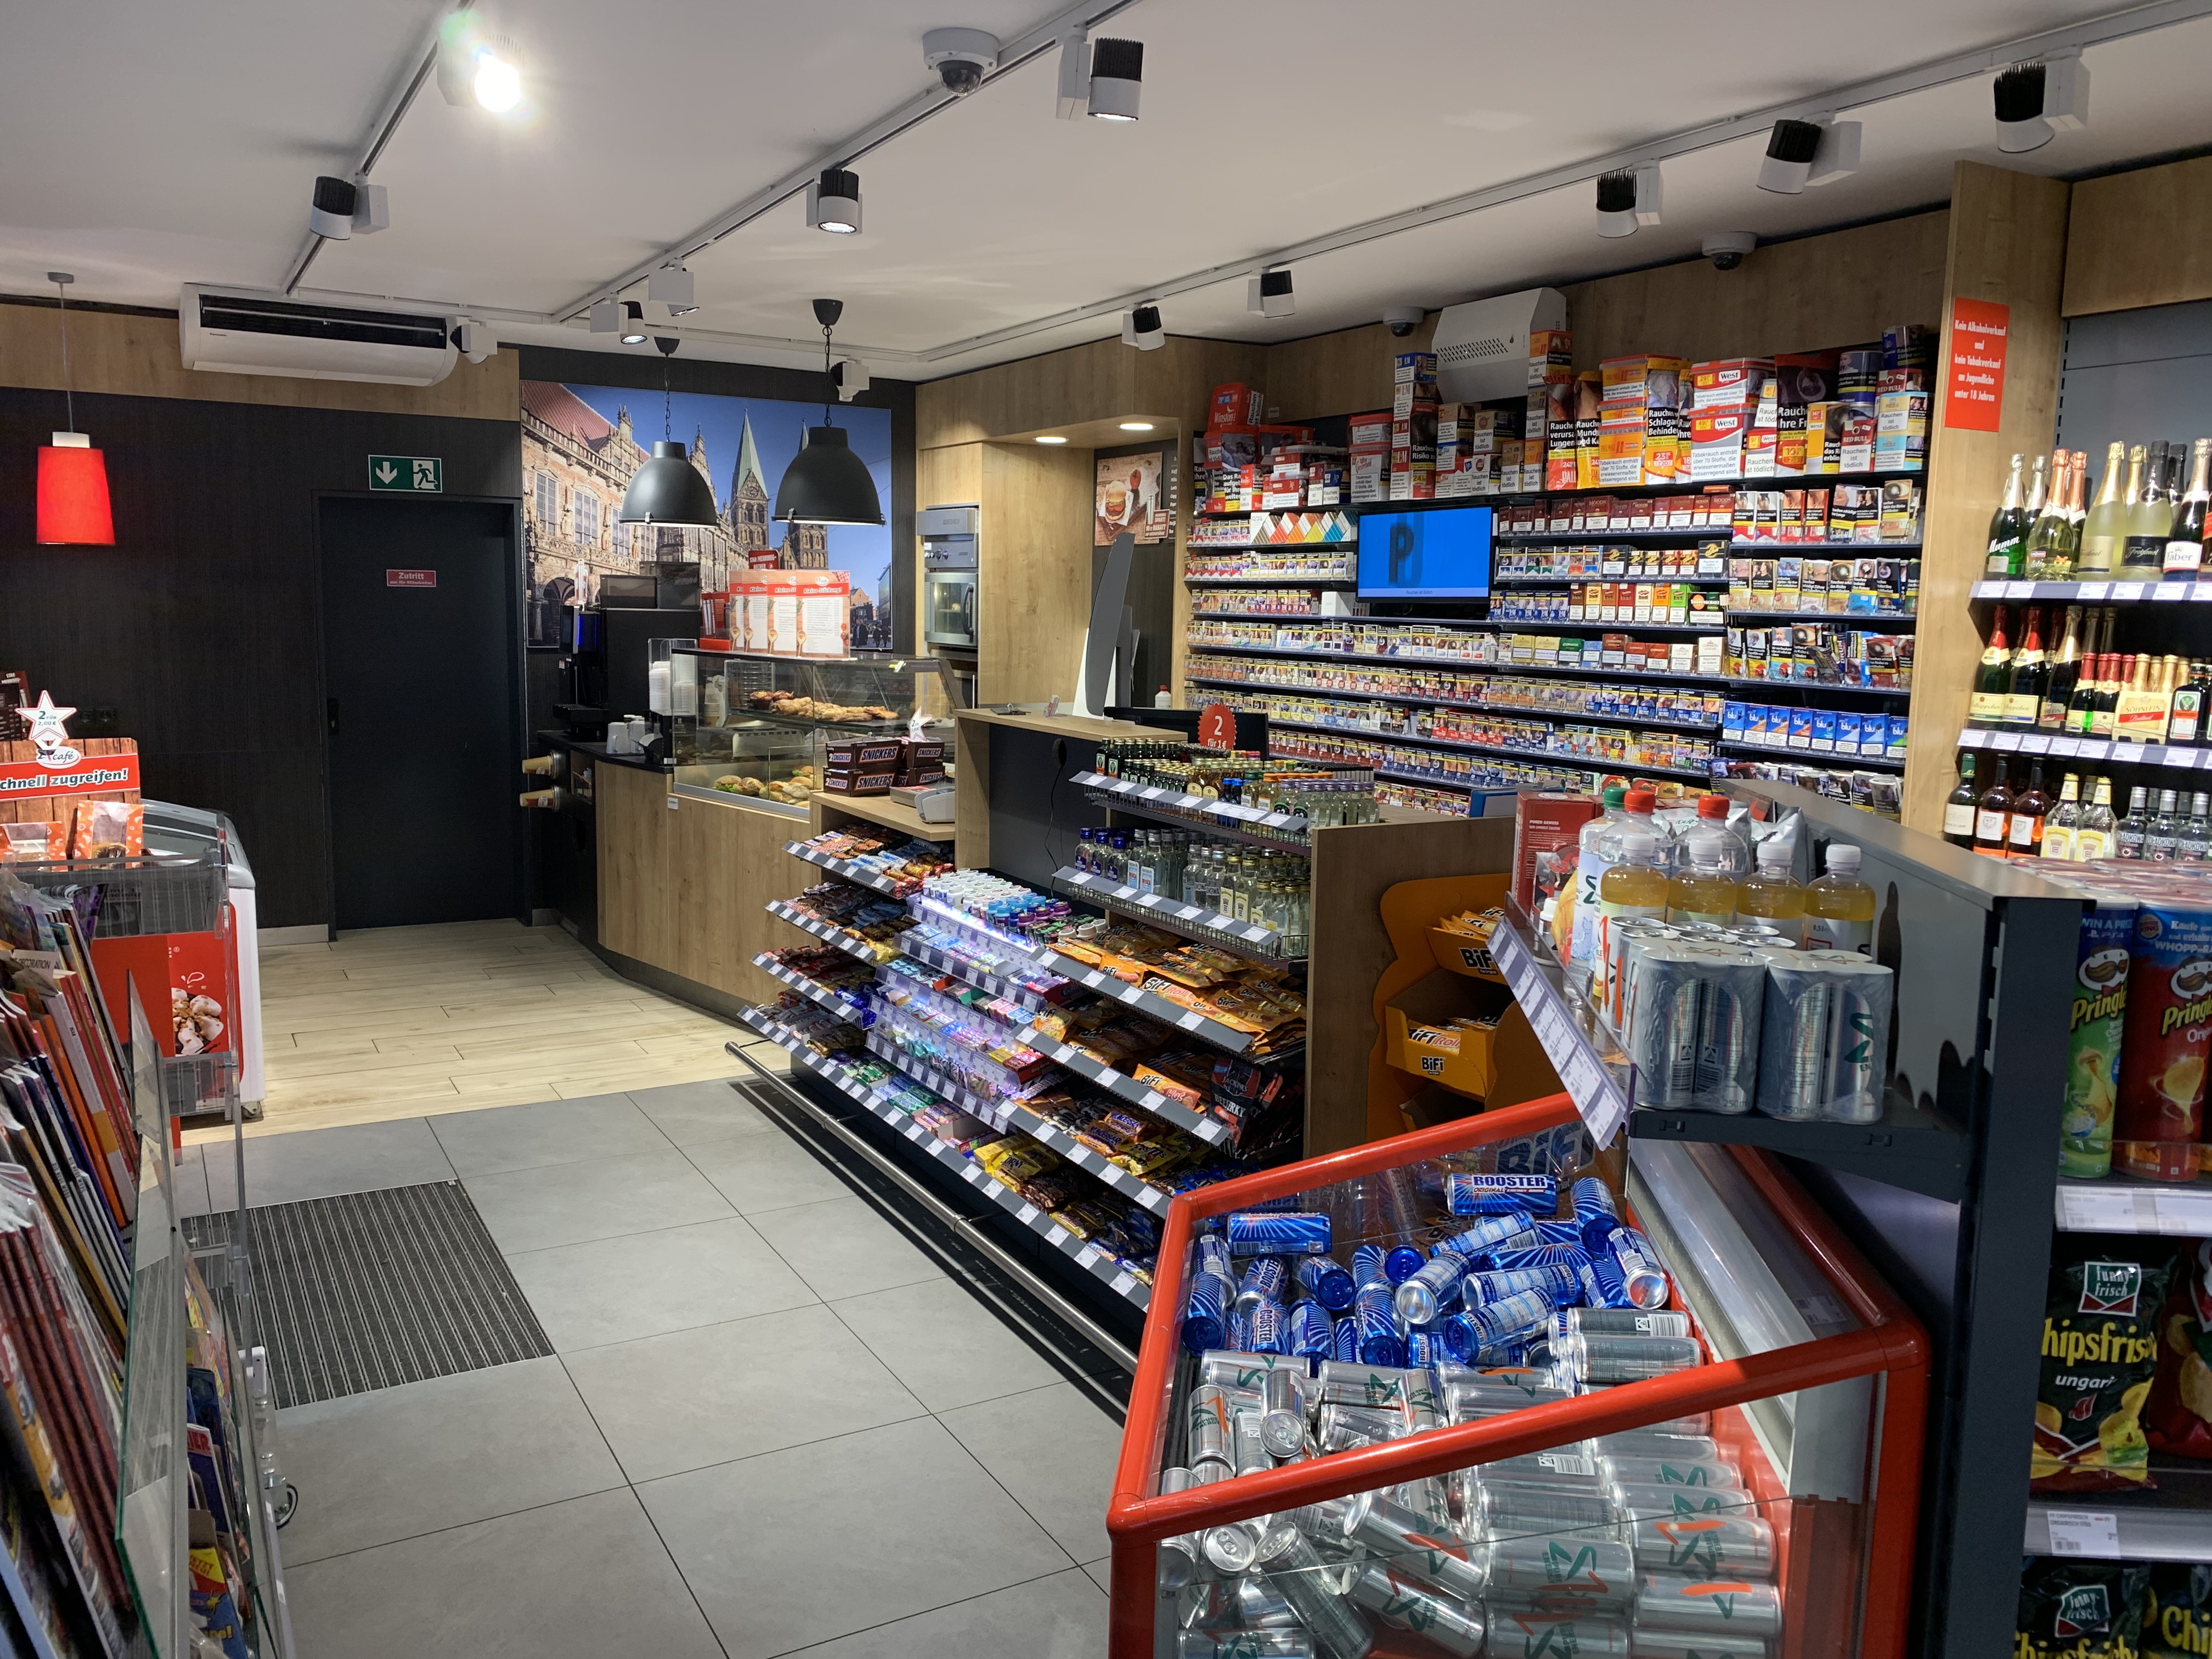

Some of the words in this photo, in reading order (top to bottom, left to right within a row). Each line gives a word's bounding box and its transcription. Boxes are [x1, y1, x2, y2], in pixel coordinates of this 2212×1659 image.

[1955, 320, 1967, 330] Kein
[1974, 340, 1984, 350] und
[1955, 354, 1966, 365] kein
[1967, 356, 2001, 369] Tabakverkauf
[1966, 373, 1995, 385] Jugendliche
[1955, 390, 1968, 399] unter
[1970, 390, 1977, 399] 18
[1978, 391, 1995, 402] Jahren
[1215, 412, 1234, 424] Winston
[1988, 535, 2020, 556] Mumm
[2128, 546, 2159, 558] Freixenet
[2126, 704, 2160, 713] SÖHNLEIN
[38, 711, 46, 719] 2
[1750, 713, 1758, 721] blu
[1771, 715, 1781, 723] blu
[1214, 716, 1223, 736] 2
[1816, 720, 1826, 728] blu
[1841, 722, 1851, 730] blu
[1865, 723, 1875, 732] blu
[1893, 727, 1903, 735] blu
[1207, 738, 1217, 747] für
[53, 751, 75, 764] café
[829, 753, 833, 762] 2
[861, 748, 899, 761] SNICKERS
[0, 777, 46, 789] chnell
[51, 769, 127, 785] zugreifen!
[825, 778, 830, 786] 2
[830, 778, 847, 788] SNICKERS
[858, 775, 893, 788] SNICKERS
[921, 773, 943, 782] SNICKERS
[2104, 919, 2113, 928] A
[2171, 921, 2198, 931] Kaufe
[1460, 948, 1498, 969] BiF
[1103, 966, 1117, 977] BiFi
[2070, 985, 2127, 1031] Pringle
[1421, 1057, 1444, 1071] BiFi
[1141, 1075, 1163, 1086] BiFi
[1167, 1089, 1185, 1101] Hot
[1473, 1176, 1547, 1187] BOOSTER
[1562, 1265, 1577, 1296] BOOSTER
[2096, 1266, 2134, 1283] funny-
[2095, 1283, 2128, 1296] frisch
[1260, 1309, 1274, 1342] BOOSTER
[2055, 1375, 2117, 1391] ungari
